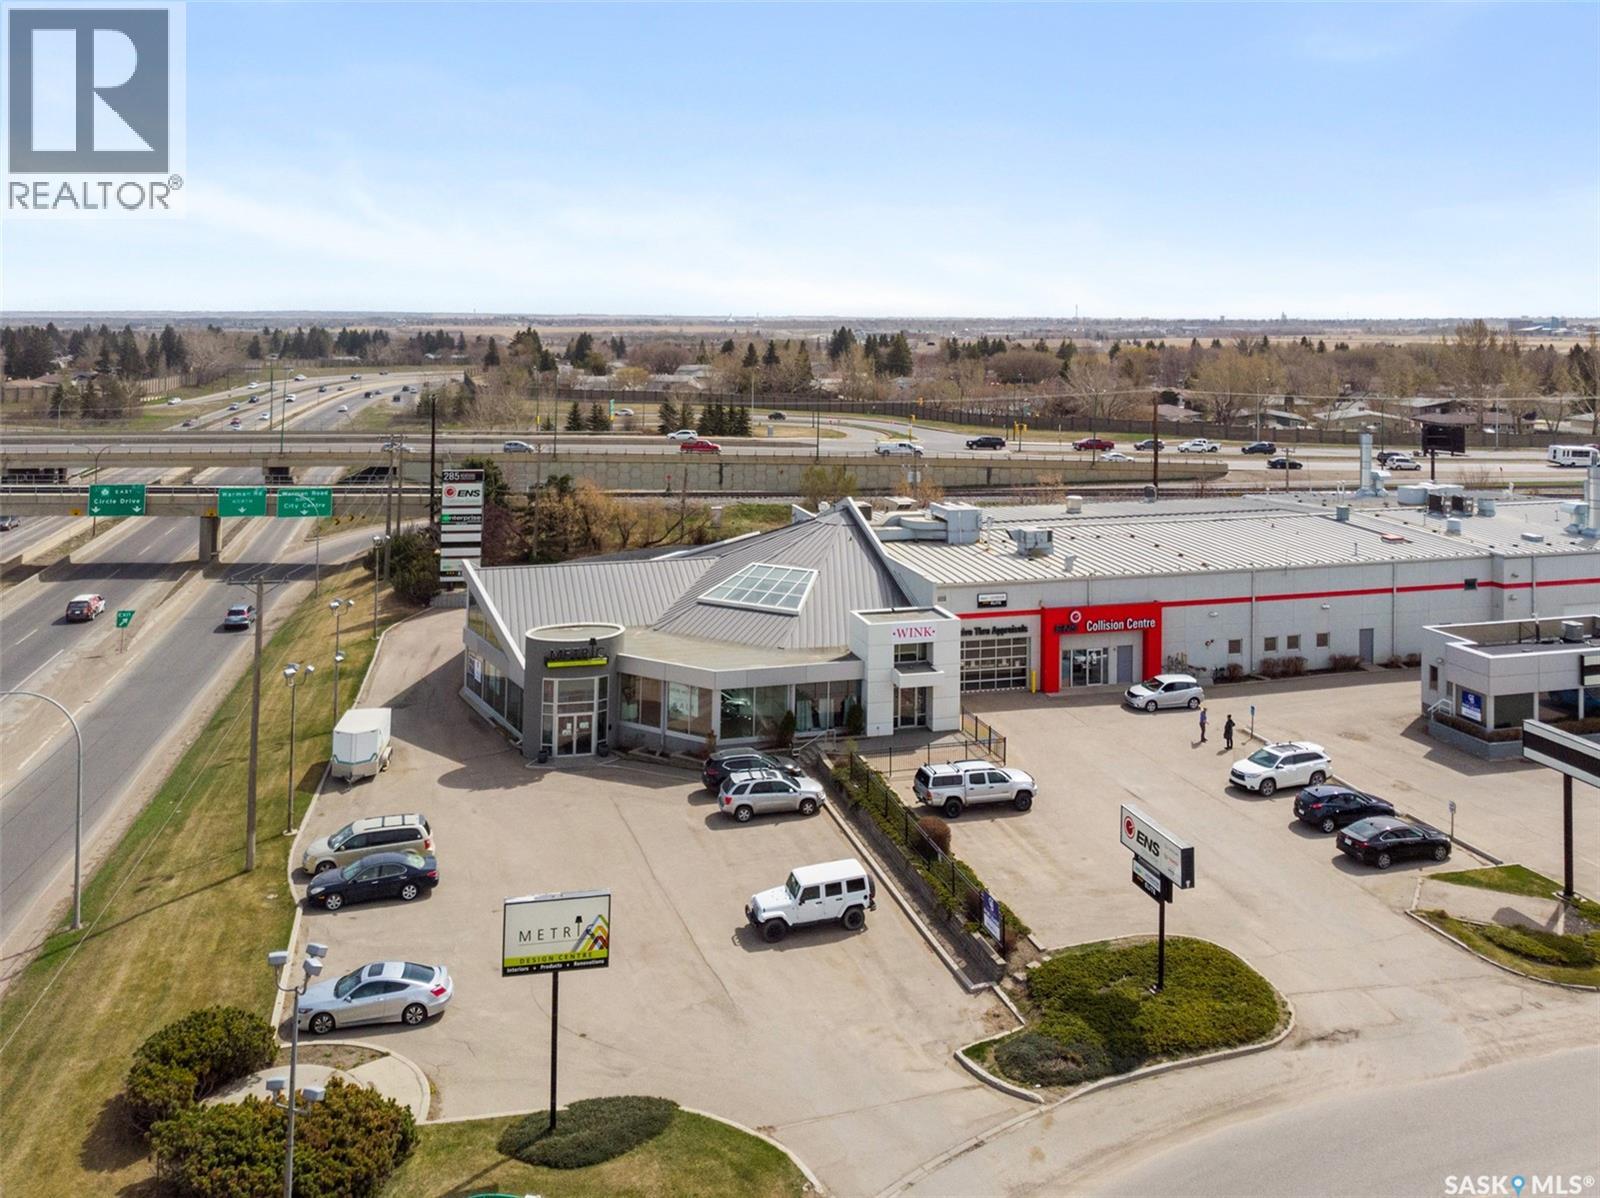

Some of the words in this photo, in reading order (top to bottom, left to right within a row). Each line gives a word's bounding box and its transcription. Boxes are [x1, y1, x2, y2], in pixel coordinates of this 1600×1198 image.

[443, 472, 460, 481] 285
[457, 489, 480, 497] ENS
[991, 624, 1028, 636] Appraisals
[1086, 620, 1124, 632] Collision
[1126, 617, 1156, 629] Centre
[896, 626, 933, 638] WINK
[1135, 830, 1160, 857] ENS
[519, 956, 554, 965] DESIGN
[558, 952, 593, 961] CENTRE
[506, 966, 529, 974] Interiors
[573, 959, 605, 967] Renovations
